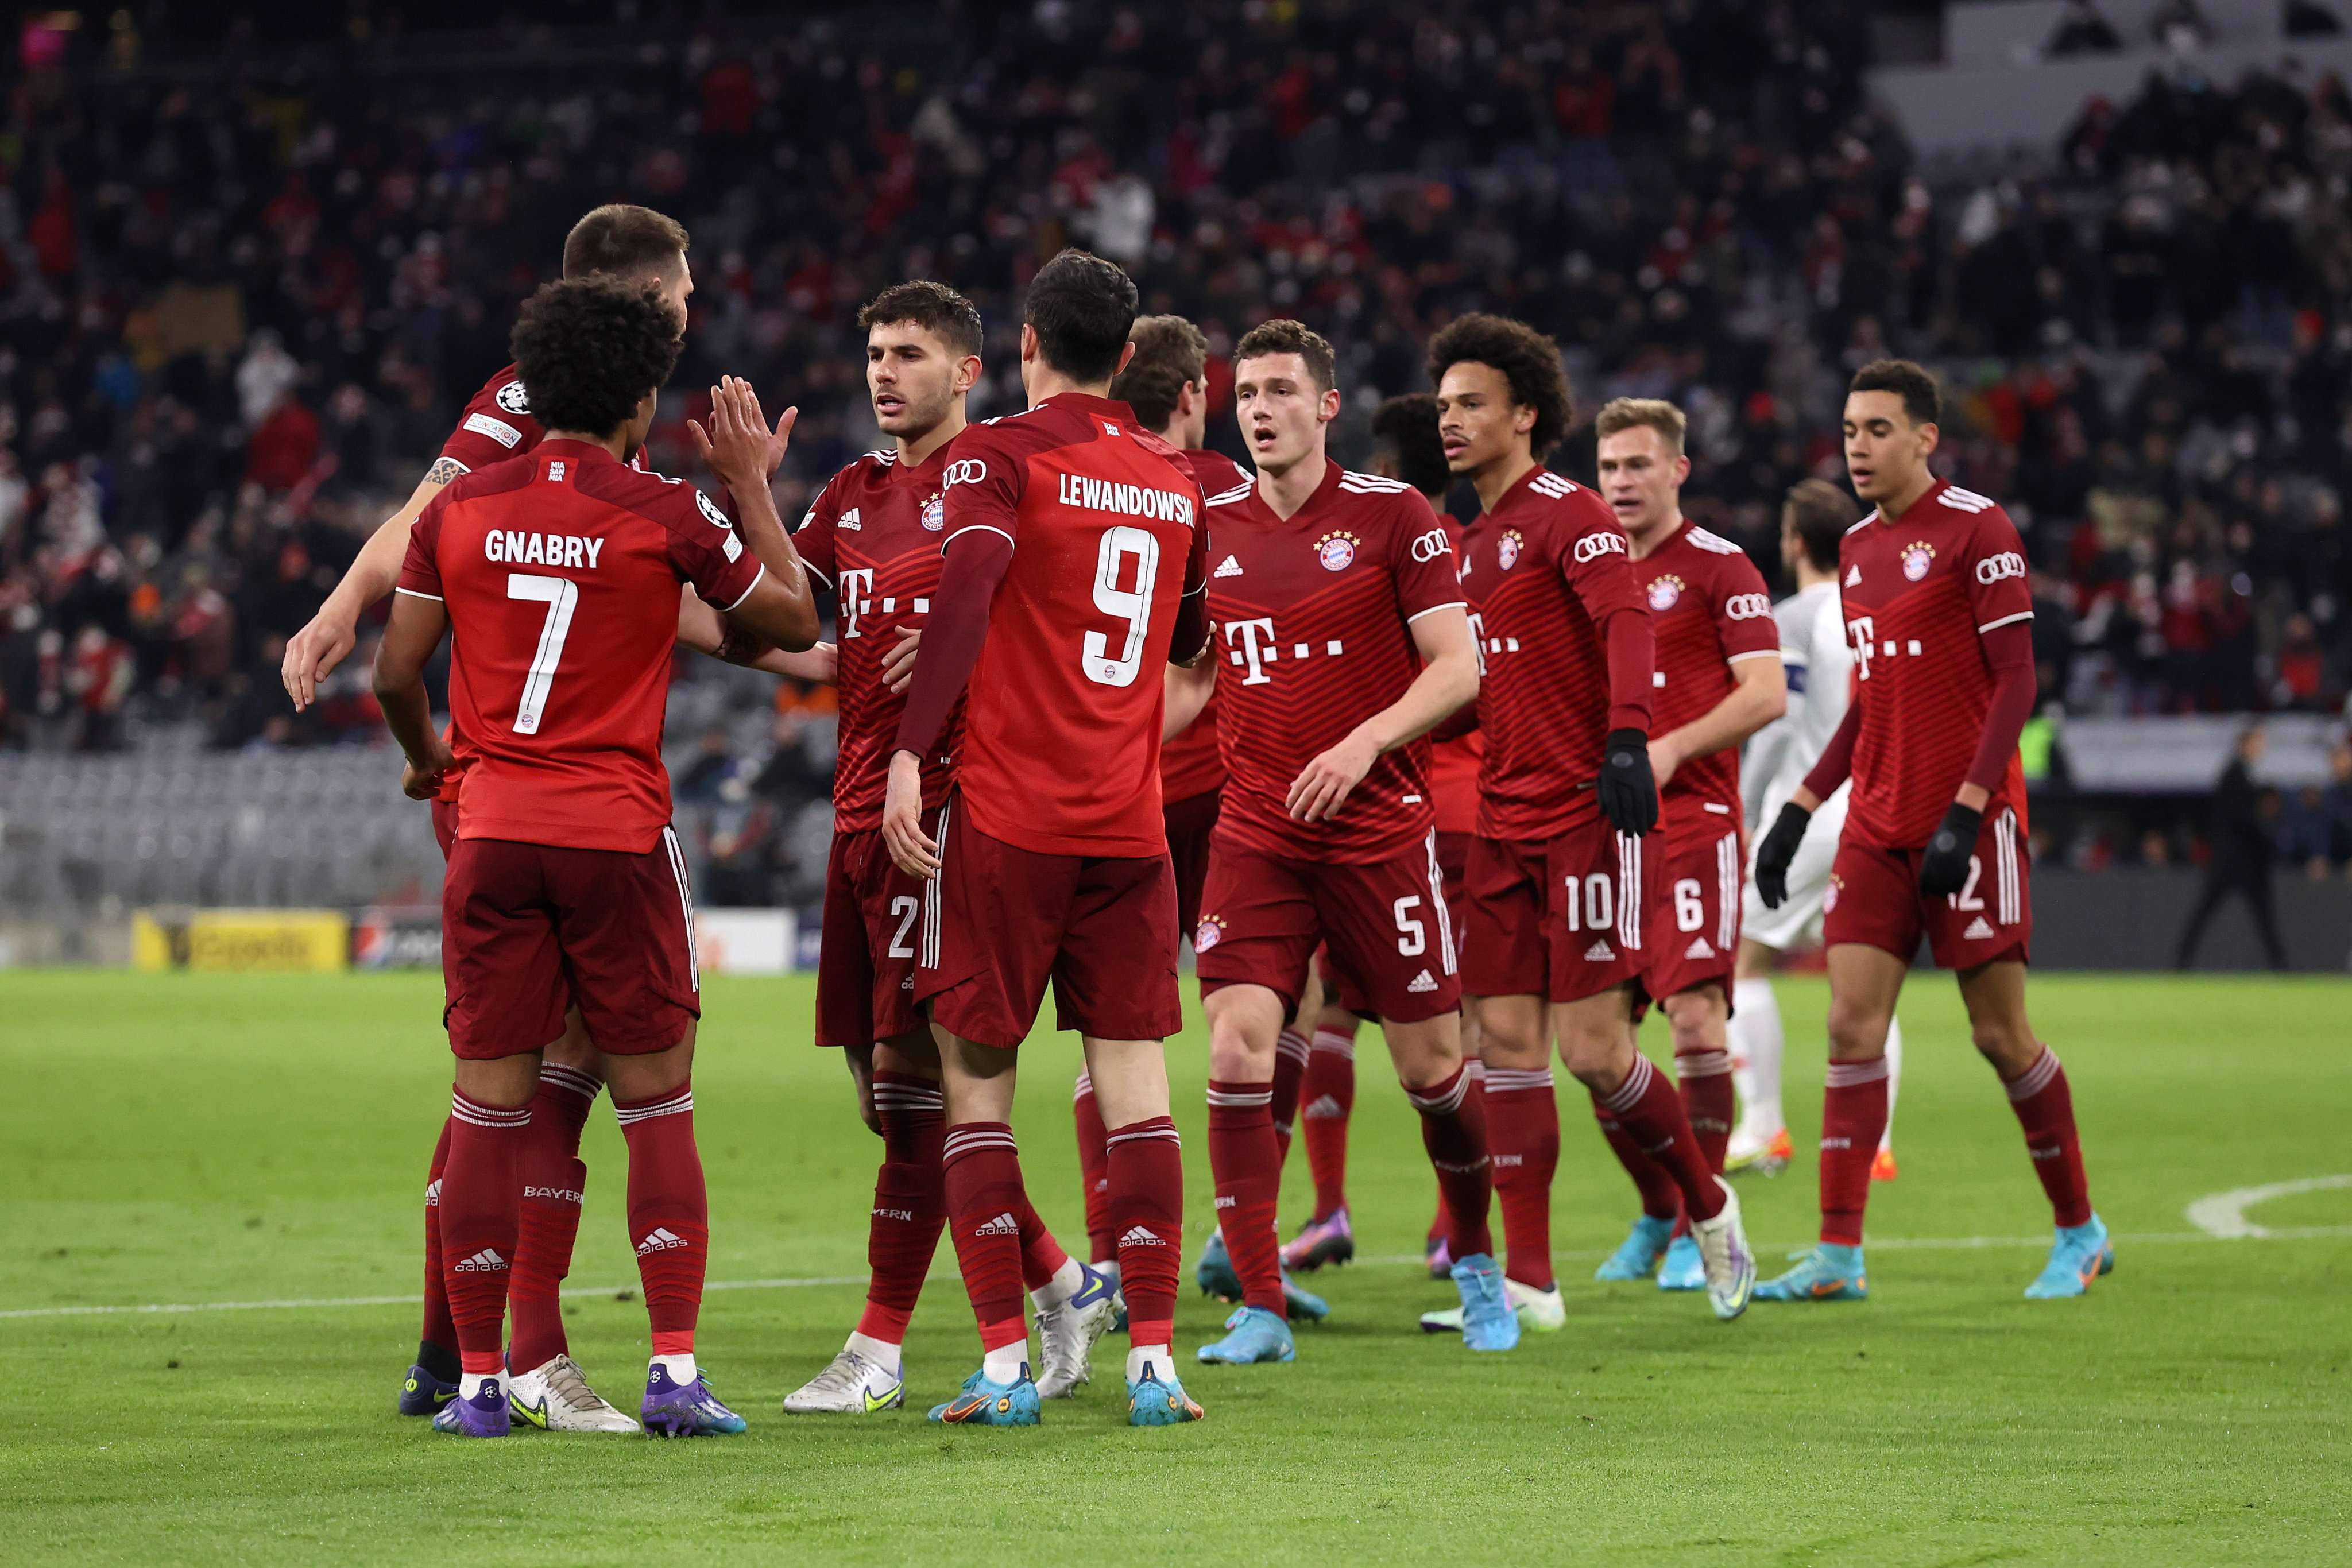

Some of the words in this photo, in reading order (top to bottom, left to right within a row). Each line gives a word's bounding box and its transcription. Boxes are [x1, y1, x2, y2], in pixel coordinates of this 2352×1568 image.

[549, 468, 565, 476] SAN
[1059, 473, 1195, 529] LEWANDOWSKI
[485, 529, 604, 568] GNABRY
[1082, 526, 1159, 687] 9
[507, 574, 578, 735] 7
[1225, 618, 1278, 686] T
[1565, 873, 1613, 932] 10
[1674, 878, 1704, 932] 6
[1948, 855, 1984, 911] 2
[888, 896, 918, 958] 2
[1394, 895, 1425, 957] 5
[871, 1208, 911, 1221] YERN
[1119, 1237, 1167, 1248] adidas
[455, 1263, 509, 1272] adidas
[636, 1239, 688, 1257] adidas
